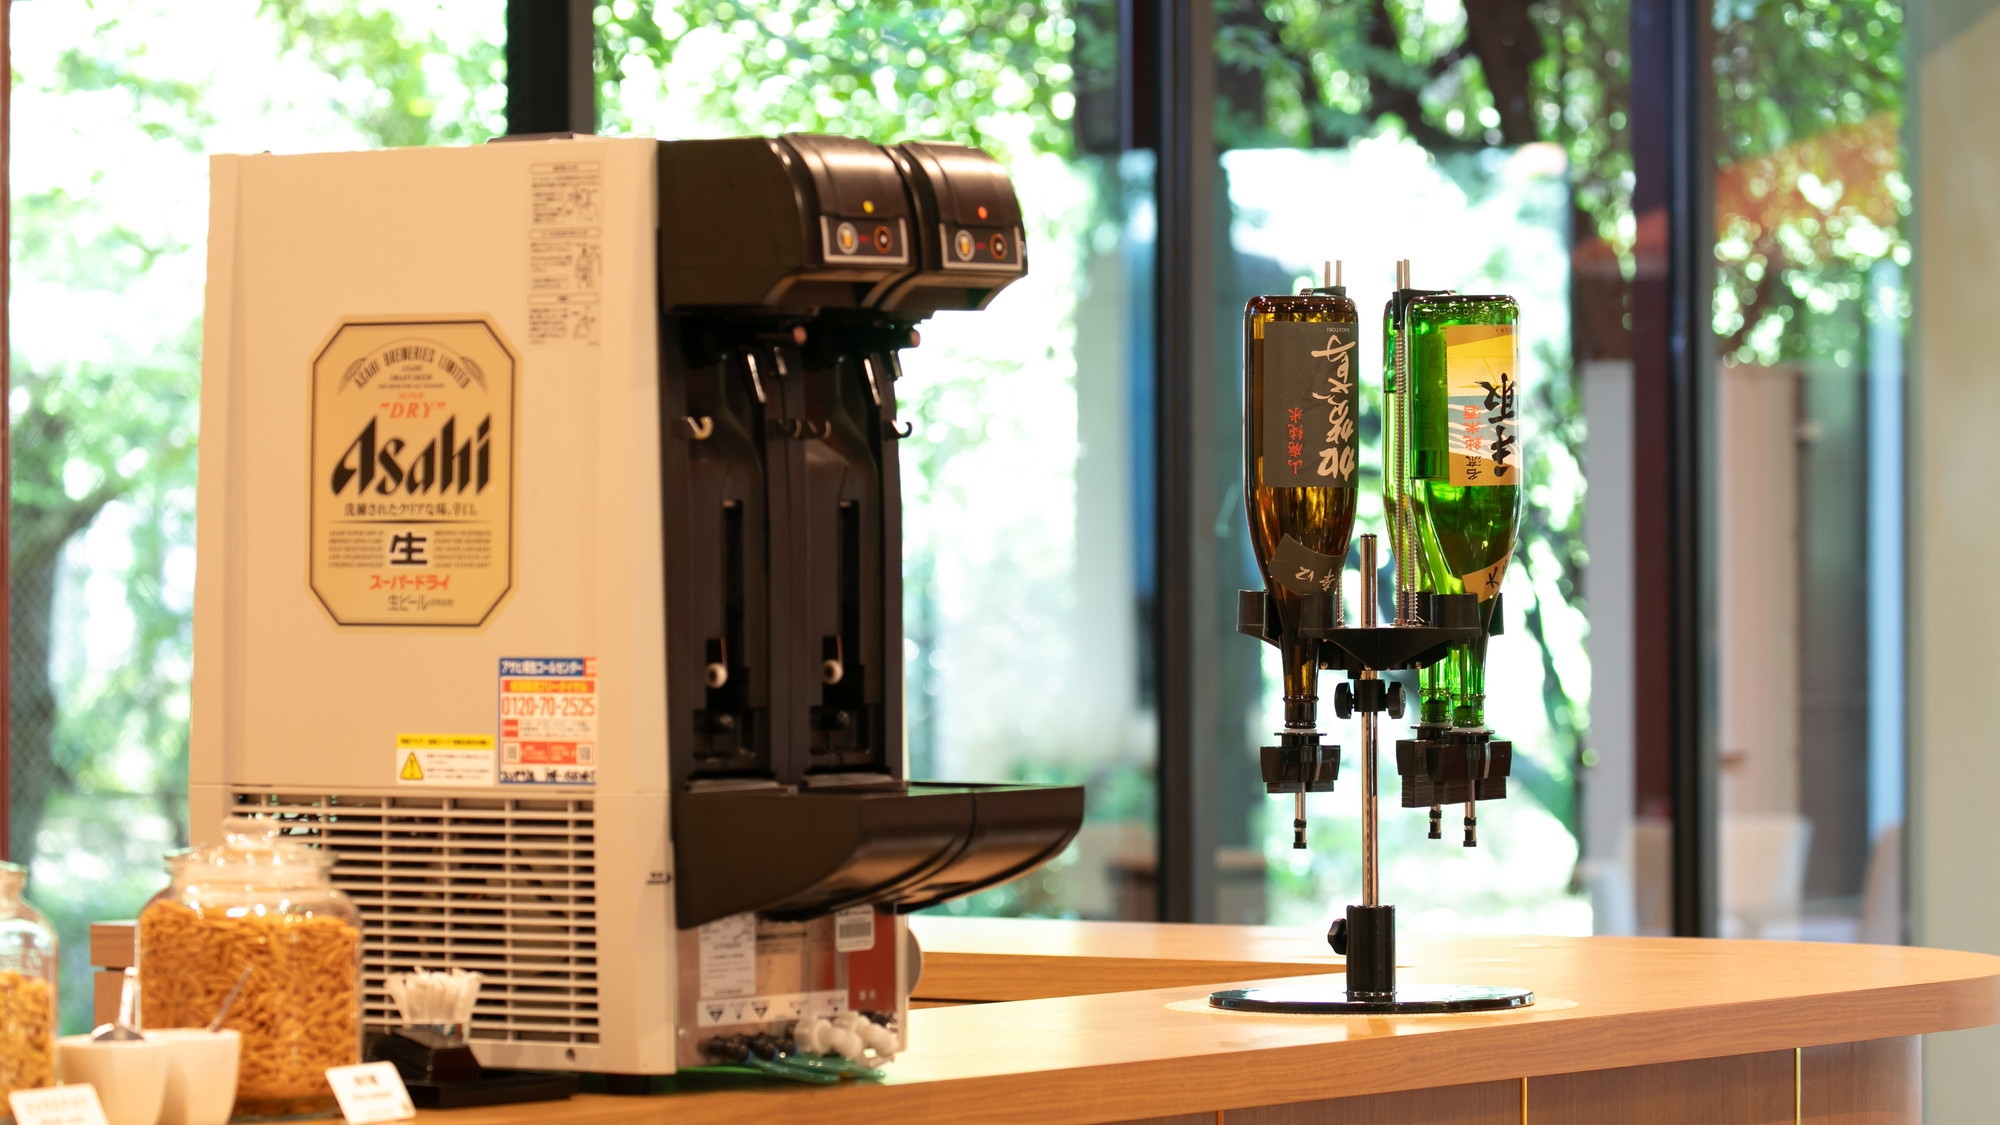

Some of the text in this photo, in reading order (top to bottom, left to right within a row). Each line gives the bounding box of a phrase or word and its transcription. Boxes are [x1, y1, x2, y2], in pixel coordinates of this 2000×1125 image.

[354, 346, 471, 390] ASAHI BREWERIES LIMITED
[1463, 405, 1482, 451] 純米酒
[331, 412, 491, 496] Asahi
[389, 531, 428, 566] 生
[369, 574, 451, 591] スーパードライ
[502, 696, 594, 717] 0120-70-2525
